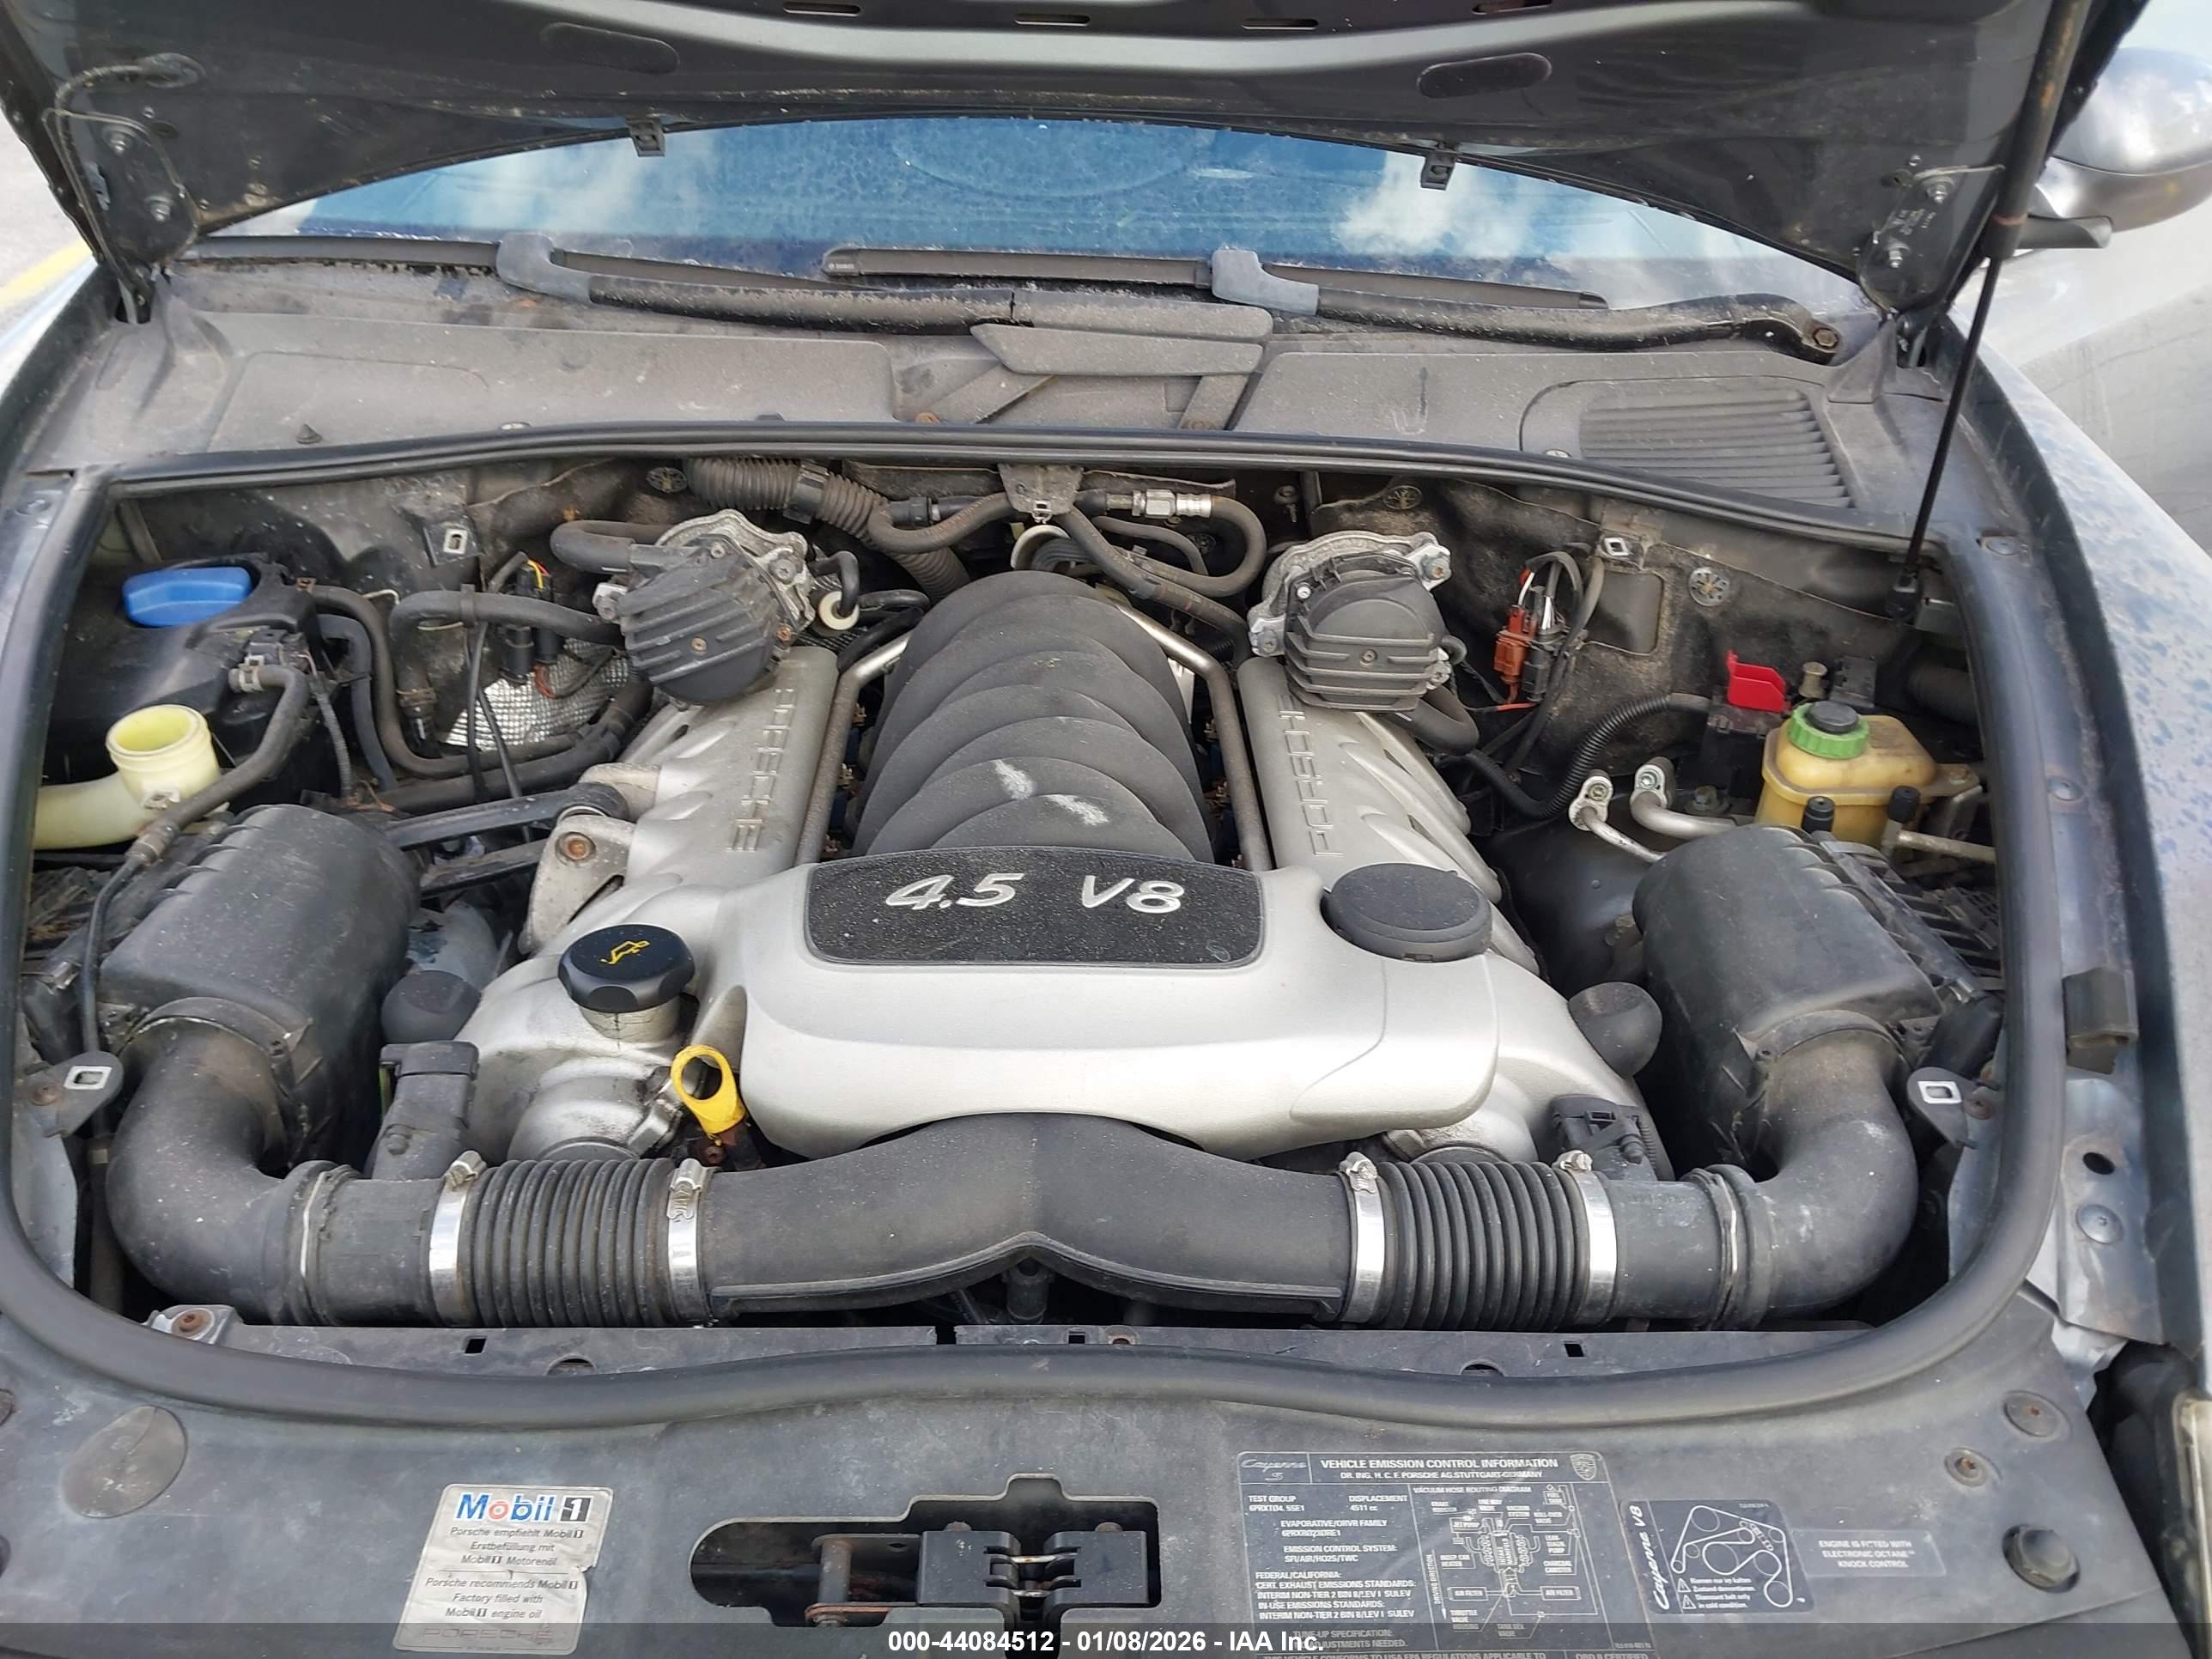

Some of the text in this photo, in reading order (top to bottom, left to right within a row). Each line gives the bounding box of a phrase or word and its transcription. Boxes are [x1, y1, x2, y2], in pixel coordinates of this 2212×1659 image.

[726, 688, 797, 852] PORSCHE
[1277, 695, 1343, 857] PORSCHE
[885, 873, 1185, 914] 4.5 V8
[1241, 1459, 1307, 1472] Cayenne
[1321, 1458, 1559, 1468] VEHICLE EMISSION CONTROL INFORMATION
[456, 1493, 587, 1522] Mobil 1
[1629, 1505, 1646, 1527] V8
[450, 1527, 492, 1537] Porsche
[494, 1528, 540, 1538] empfiehlt
[470, 1541, 535, 1553] Erstbefüllung
[506, 1556, 557, 1565] Motorenöl
[1639, 1532, 1669, 1610] Cayenne
[425, 1577, 469, 1588] Porsche
[470, 1579, 535, 1589] recommends
[453, 1593, 543, 1604] Factory filled with
[491, 1609, 526, 1620] engine
[528, 1609, 543, 1618] oil
[424, 1628, 553, 1642] PORSCHE
